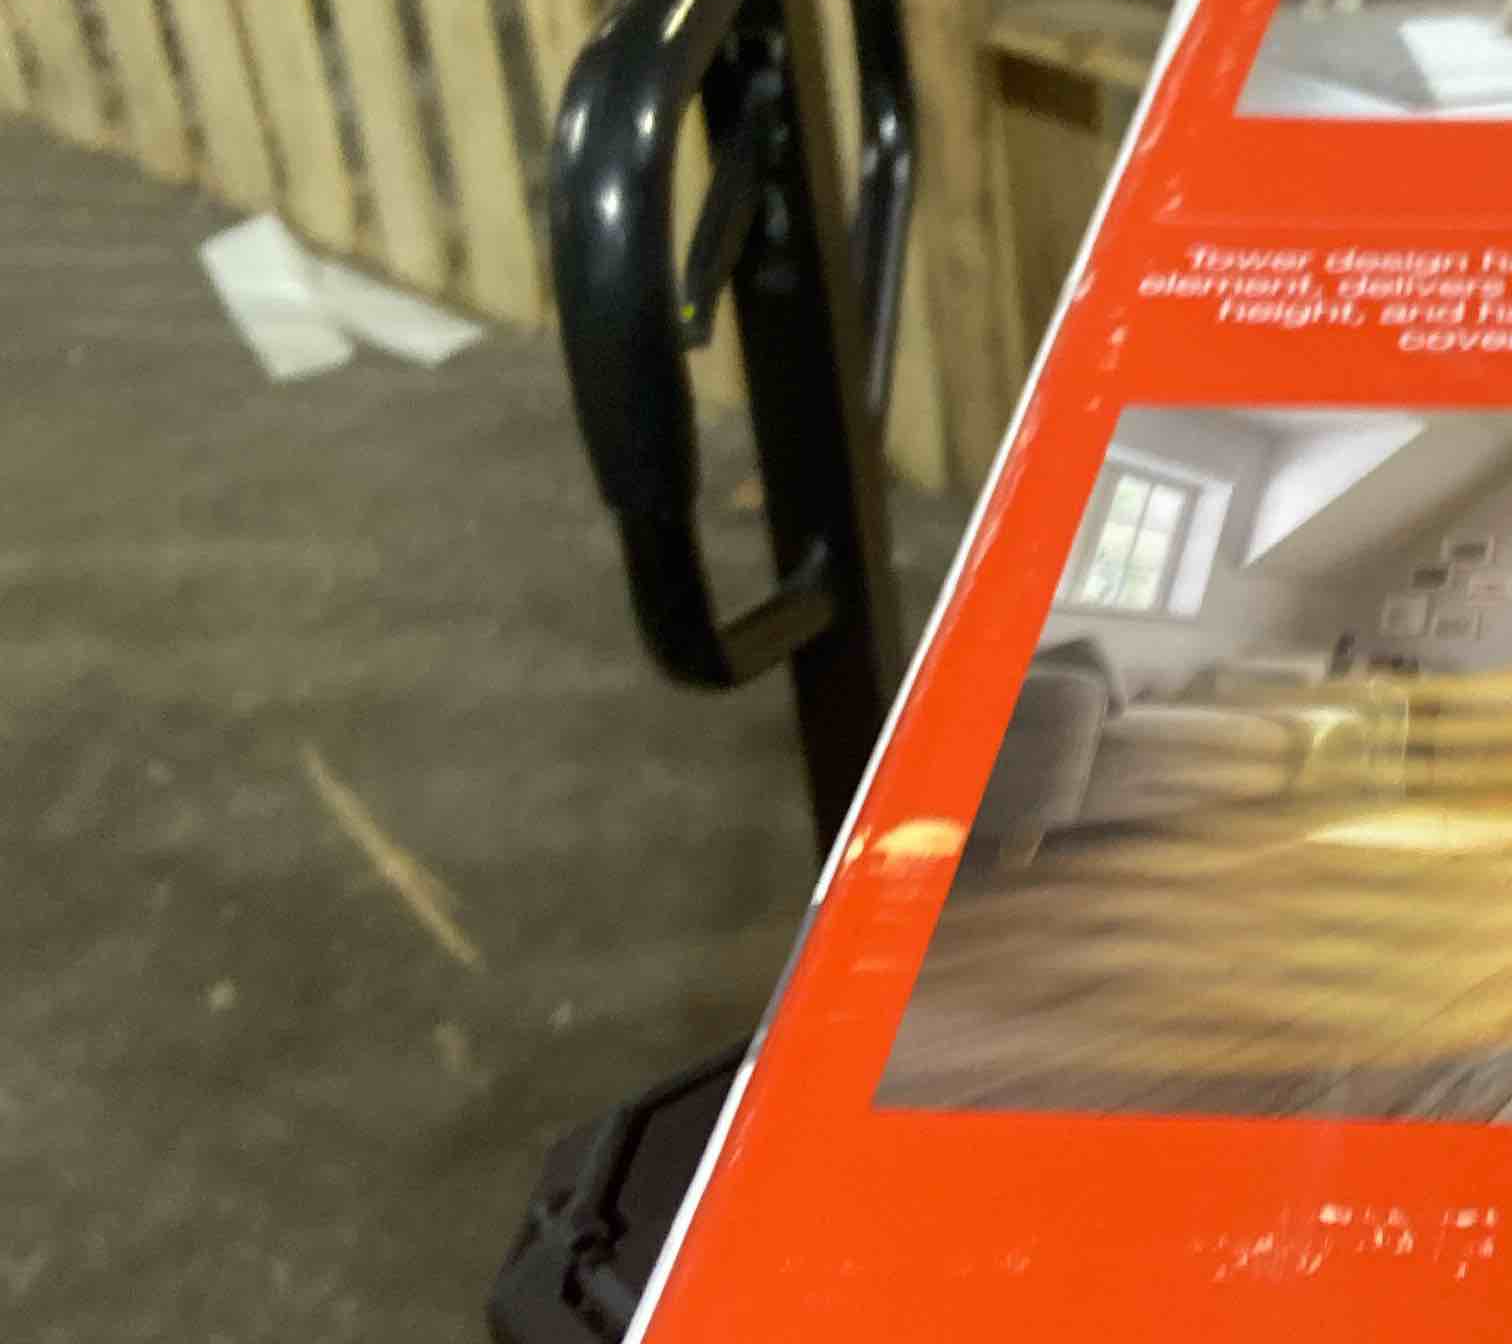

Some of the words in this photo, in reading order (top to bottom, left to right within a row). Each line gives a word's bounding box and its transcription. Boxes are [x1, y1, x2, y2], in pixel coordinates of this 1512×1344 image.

[1188, 244, 1312, 270] Tower
[1325, 244, 1468, 276] design
[1138, 271, 1324, 299] element,
[1338, 273, 1505, 297] delivers
[1217, 297, 1366, 328] height,
[1380, 299, 1466, 325] and
